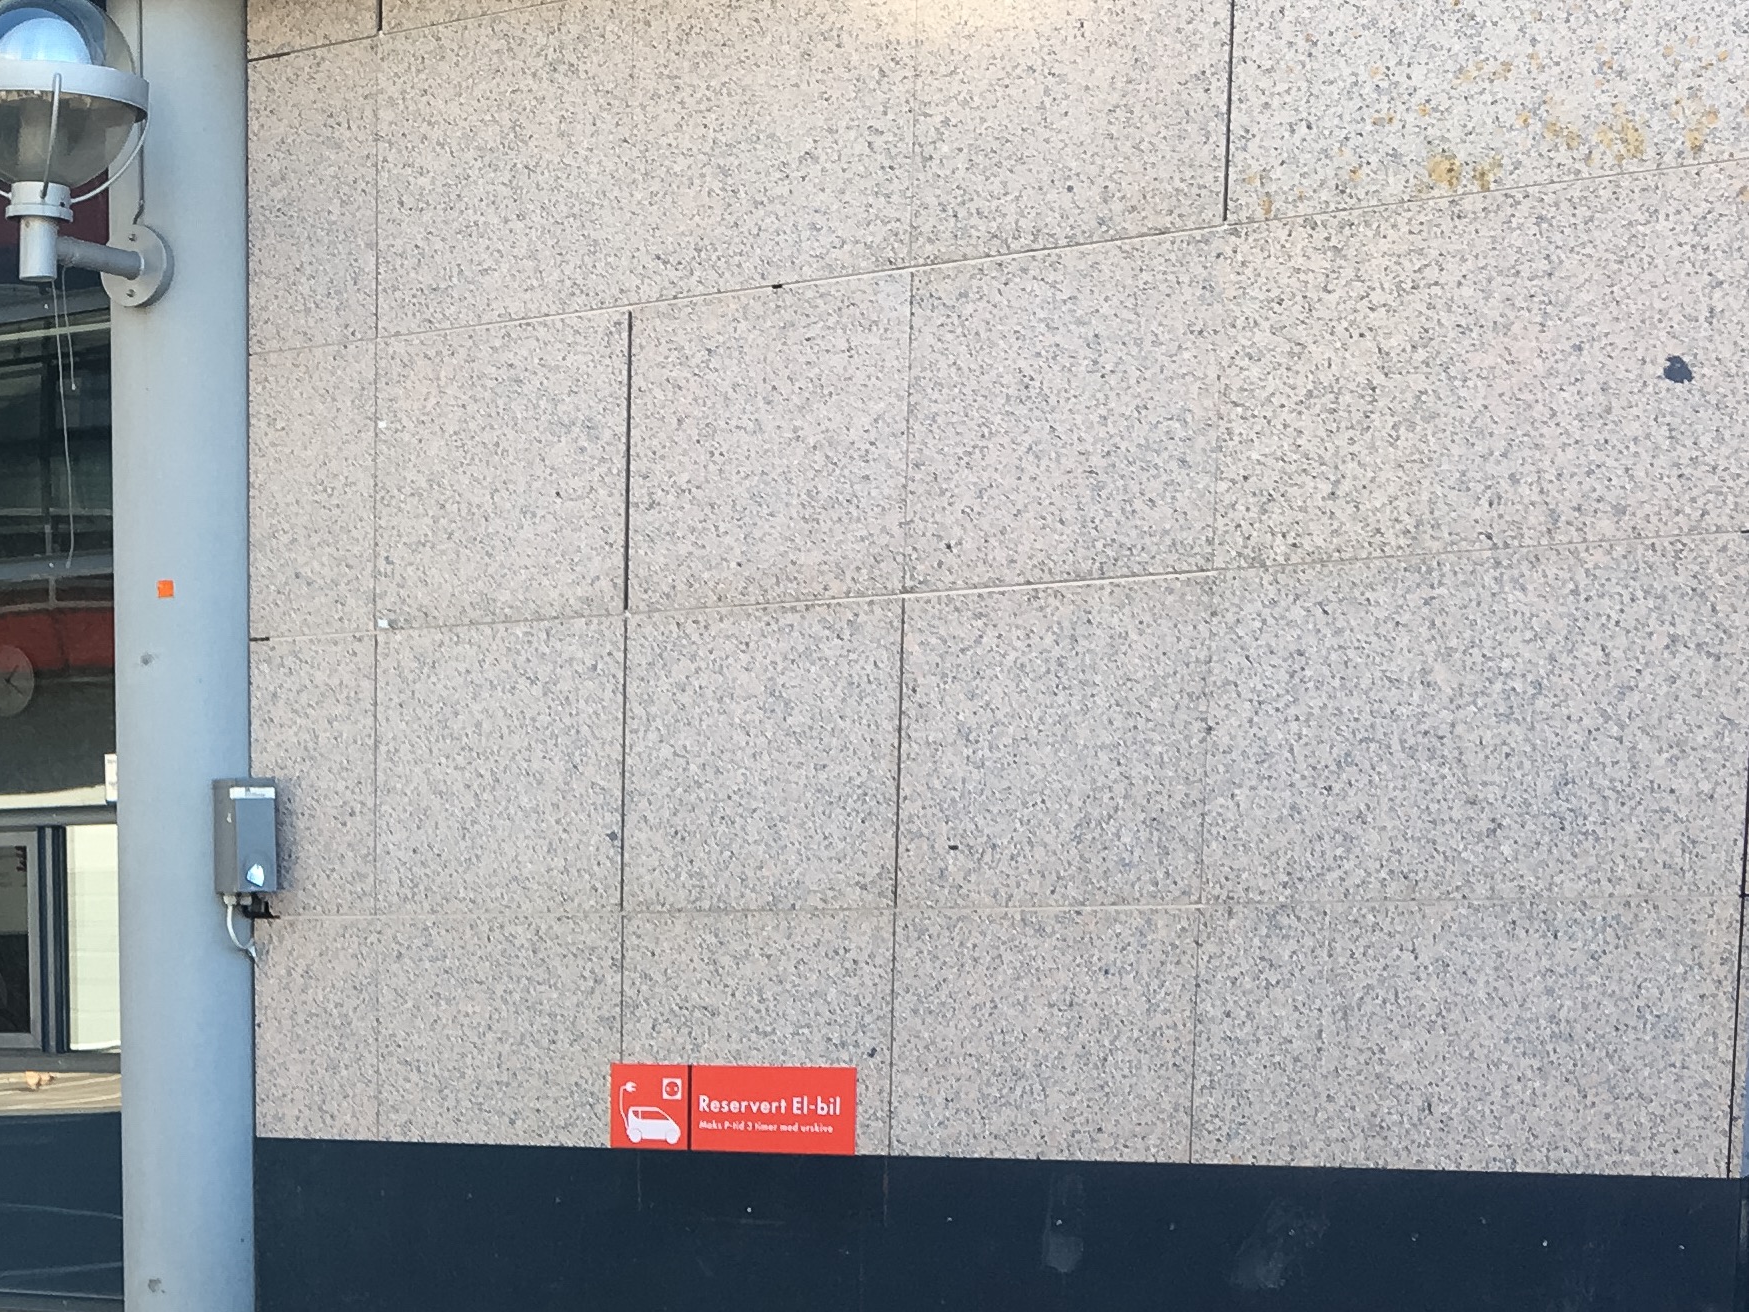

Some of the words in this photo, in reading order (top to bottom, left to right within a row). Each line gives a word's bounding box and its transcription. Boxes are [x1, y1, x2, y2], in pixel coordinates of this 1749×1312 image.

[698, 1095, 787, 1114] Reservert
[792, 1095, 841, 1115] El-bil
[699, 1120, 722, 1130] Maks
[724, 1121, 745, 1131] P-tid
[747, 1122, 753, 1131] 3
[755, 1122, 777, 1132] timer
[780, 1122, 798, 1132] med
